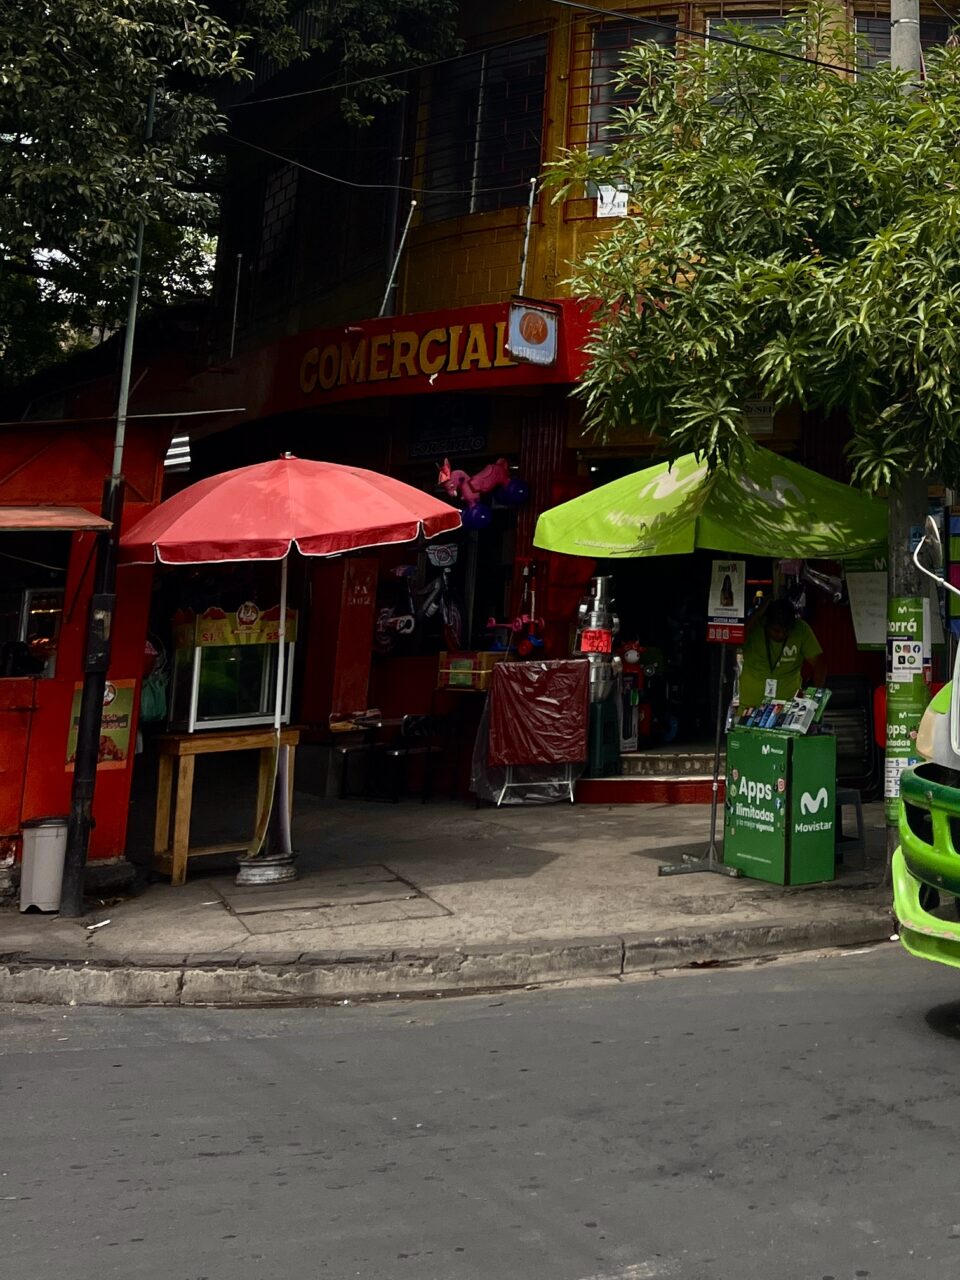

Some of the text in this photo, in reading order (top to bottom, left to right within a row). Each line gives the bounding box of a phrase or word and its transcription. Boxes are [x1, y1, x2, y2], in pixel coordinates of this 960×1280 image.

[299, 320, 520, 394] COMERCIAL
[886, 723, 907, 738] pps
[738, 775, 773, 805] Apps
[735, 802, 775, 822] ilimitadas
[794, 820, 833, 833] Movistar
